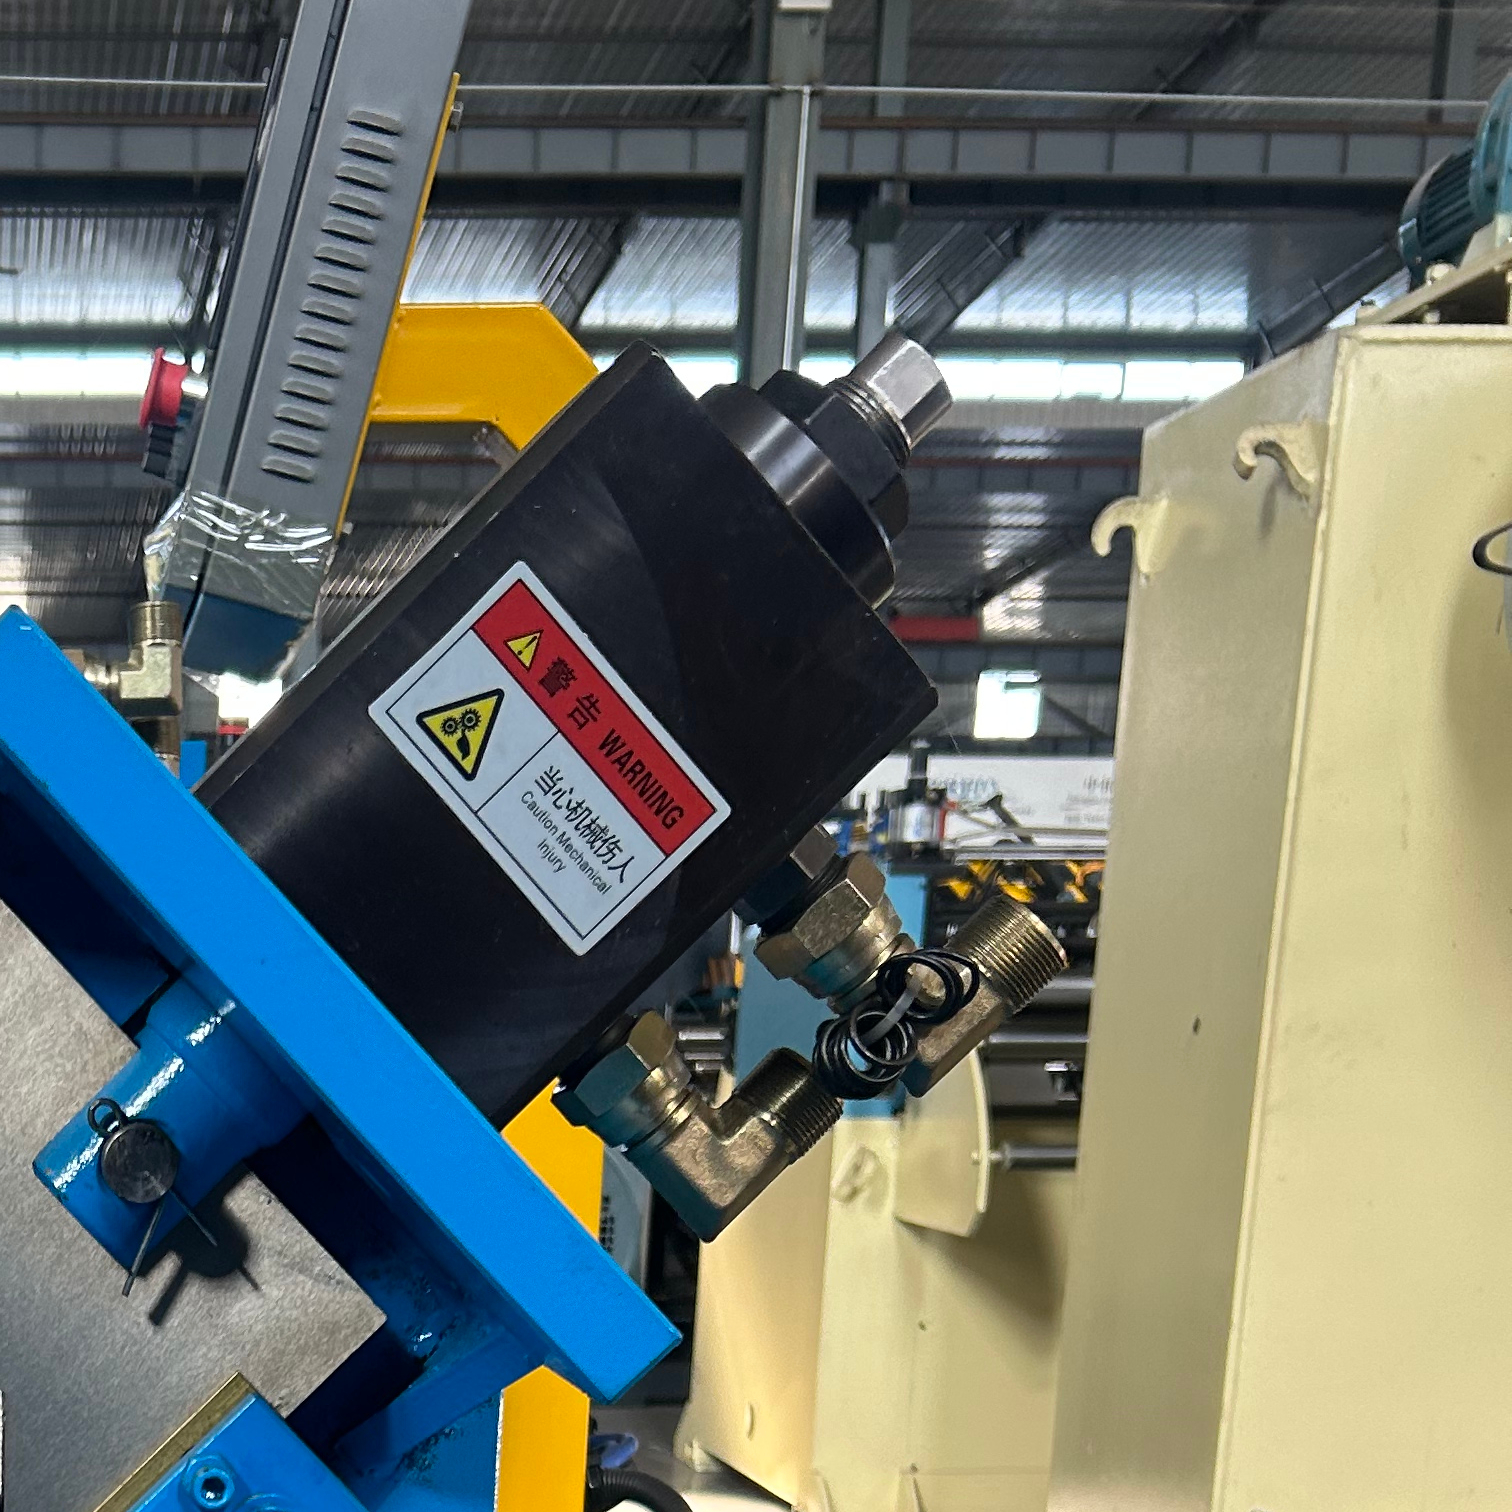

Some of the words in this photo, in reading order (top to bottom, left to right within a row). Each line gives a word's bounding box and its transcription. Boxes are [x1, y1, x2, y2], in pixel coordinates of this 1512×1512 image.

[538, 656, 602, 731] 警告
[598, 728, 685, 830] WARNING
[520, 790, 560, 837] Caution
[555, 830, 613, 896] Mechanical
[534, 765, 635, 884] 当心机械伤人
[537, 838, 567, 874] Injury
